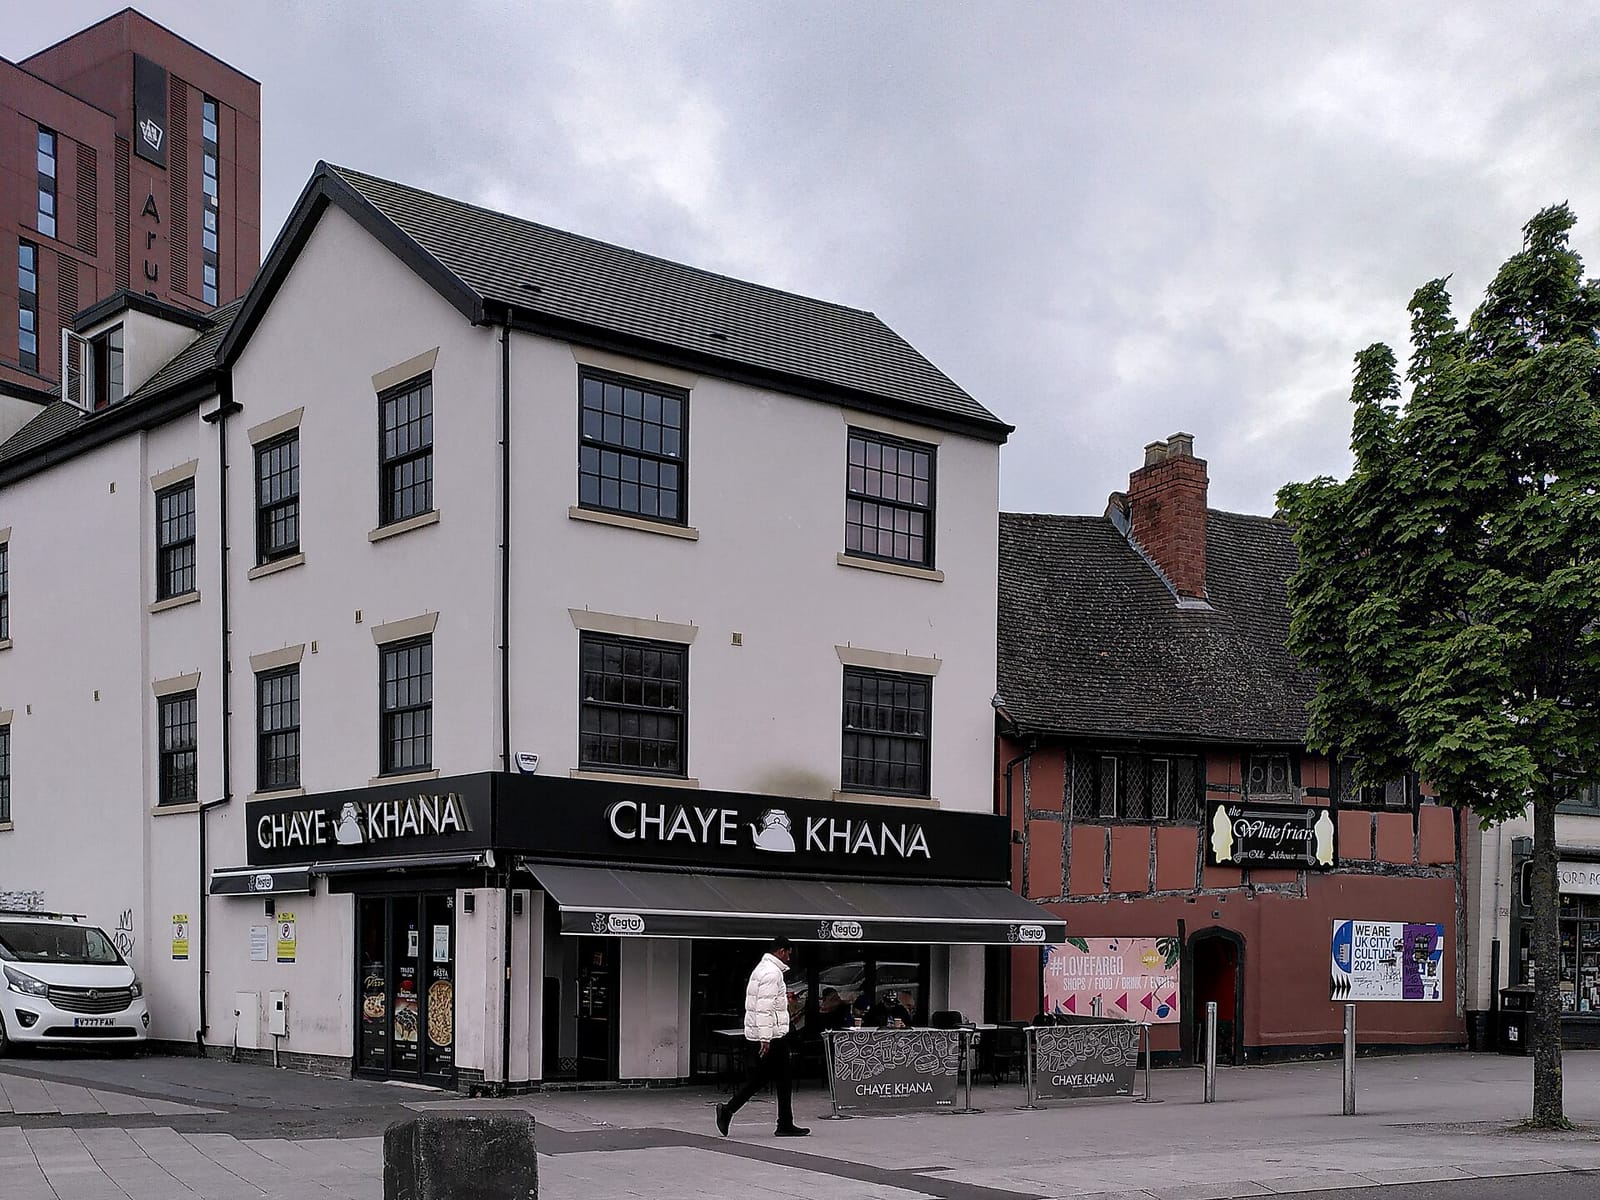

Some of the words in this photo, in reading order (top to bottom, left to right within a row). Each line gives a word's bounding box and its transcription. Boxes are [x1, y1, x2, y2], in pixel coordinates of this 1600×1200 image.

[1228, 805, 1241, 817] the
[257, 808, 327, 848] CHAYE
[368, 792, 462, 838] KHANA
[608, 800, 738, 845] CHAYE
[805, 816, 931, 859] KHANA
[1233, 818, 1314, 846] Whitefriars
[1355, 925, 1370, 936] WE
[1371, 925, 1391, 937] ARE
[1354, 937, 1368, 948] UK
[1369, 937, 1391, 948] CITY
[1049, 955, 1124, 977] #LOVEFARGO
[1354, 960, 1376, 971] 2021
[1063, 977, 1086, 991] SHOPS
[1094, 977, 1113, 990] FOOD
[1051, 1074, 1082, 1086] CHAYE
[1084, 1072, 1115, 1084] KHANA
[855, 1084, 891, 1096] CHAYE
[894, 1082, 933, 1095] KHANA
